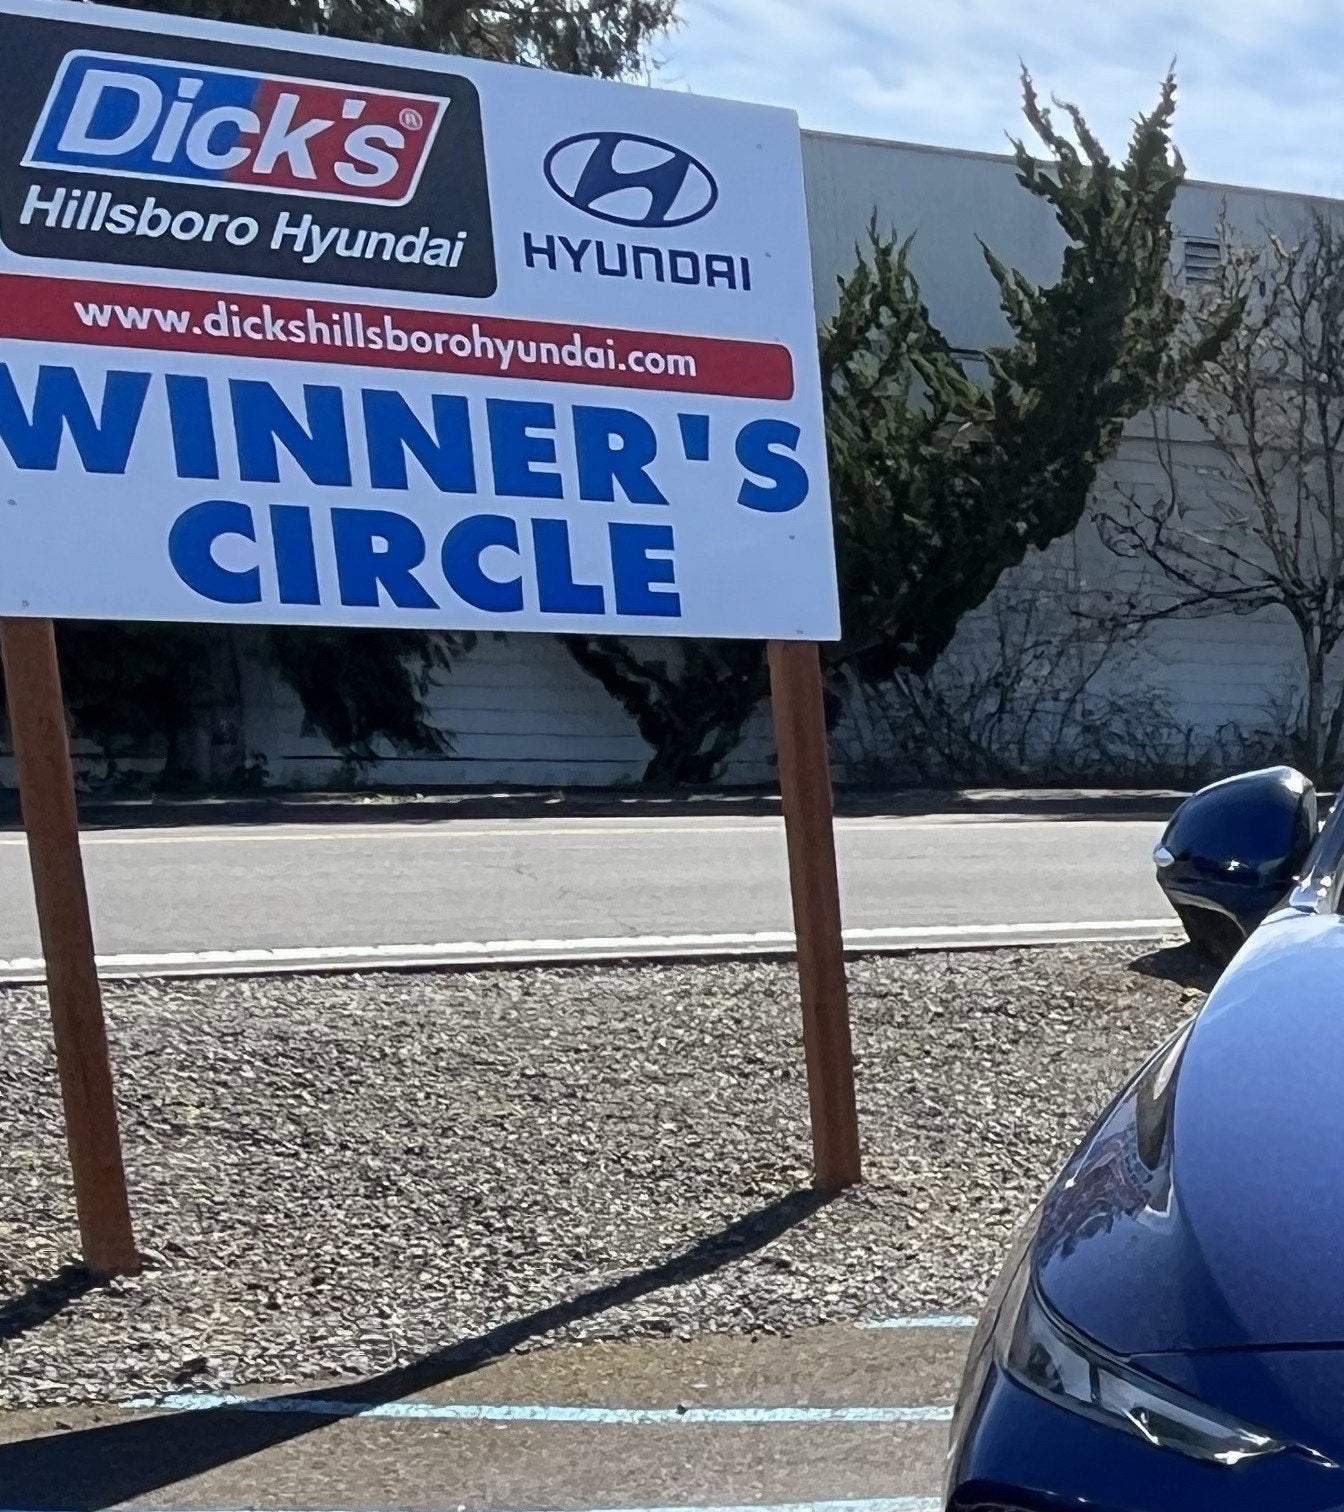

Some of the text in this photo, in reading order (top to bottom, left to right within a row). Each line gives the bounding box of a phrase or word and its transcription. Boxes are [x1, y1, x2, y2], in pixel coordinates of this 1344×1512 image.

[19, 185, 467, 268] Hillsboro Hyundai
[524, 231, 753, 292] HYUNDAI
[74, 299, 697, 377] www.dickshillsborohyundai.com
[0, 361, 810, 514] WINNER'S
[168, 500, 683, 619] CIRCLE
